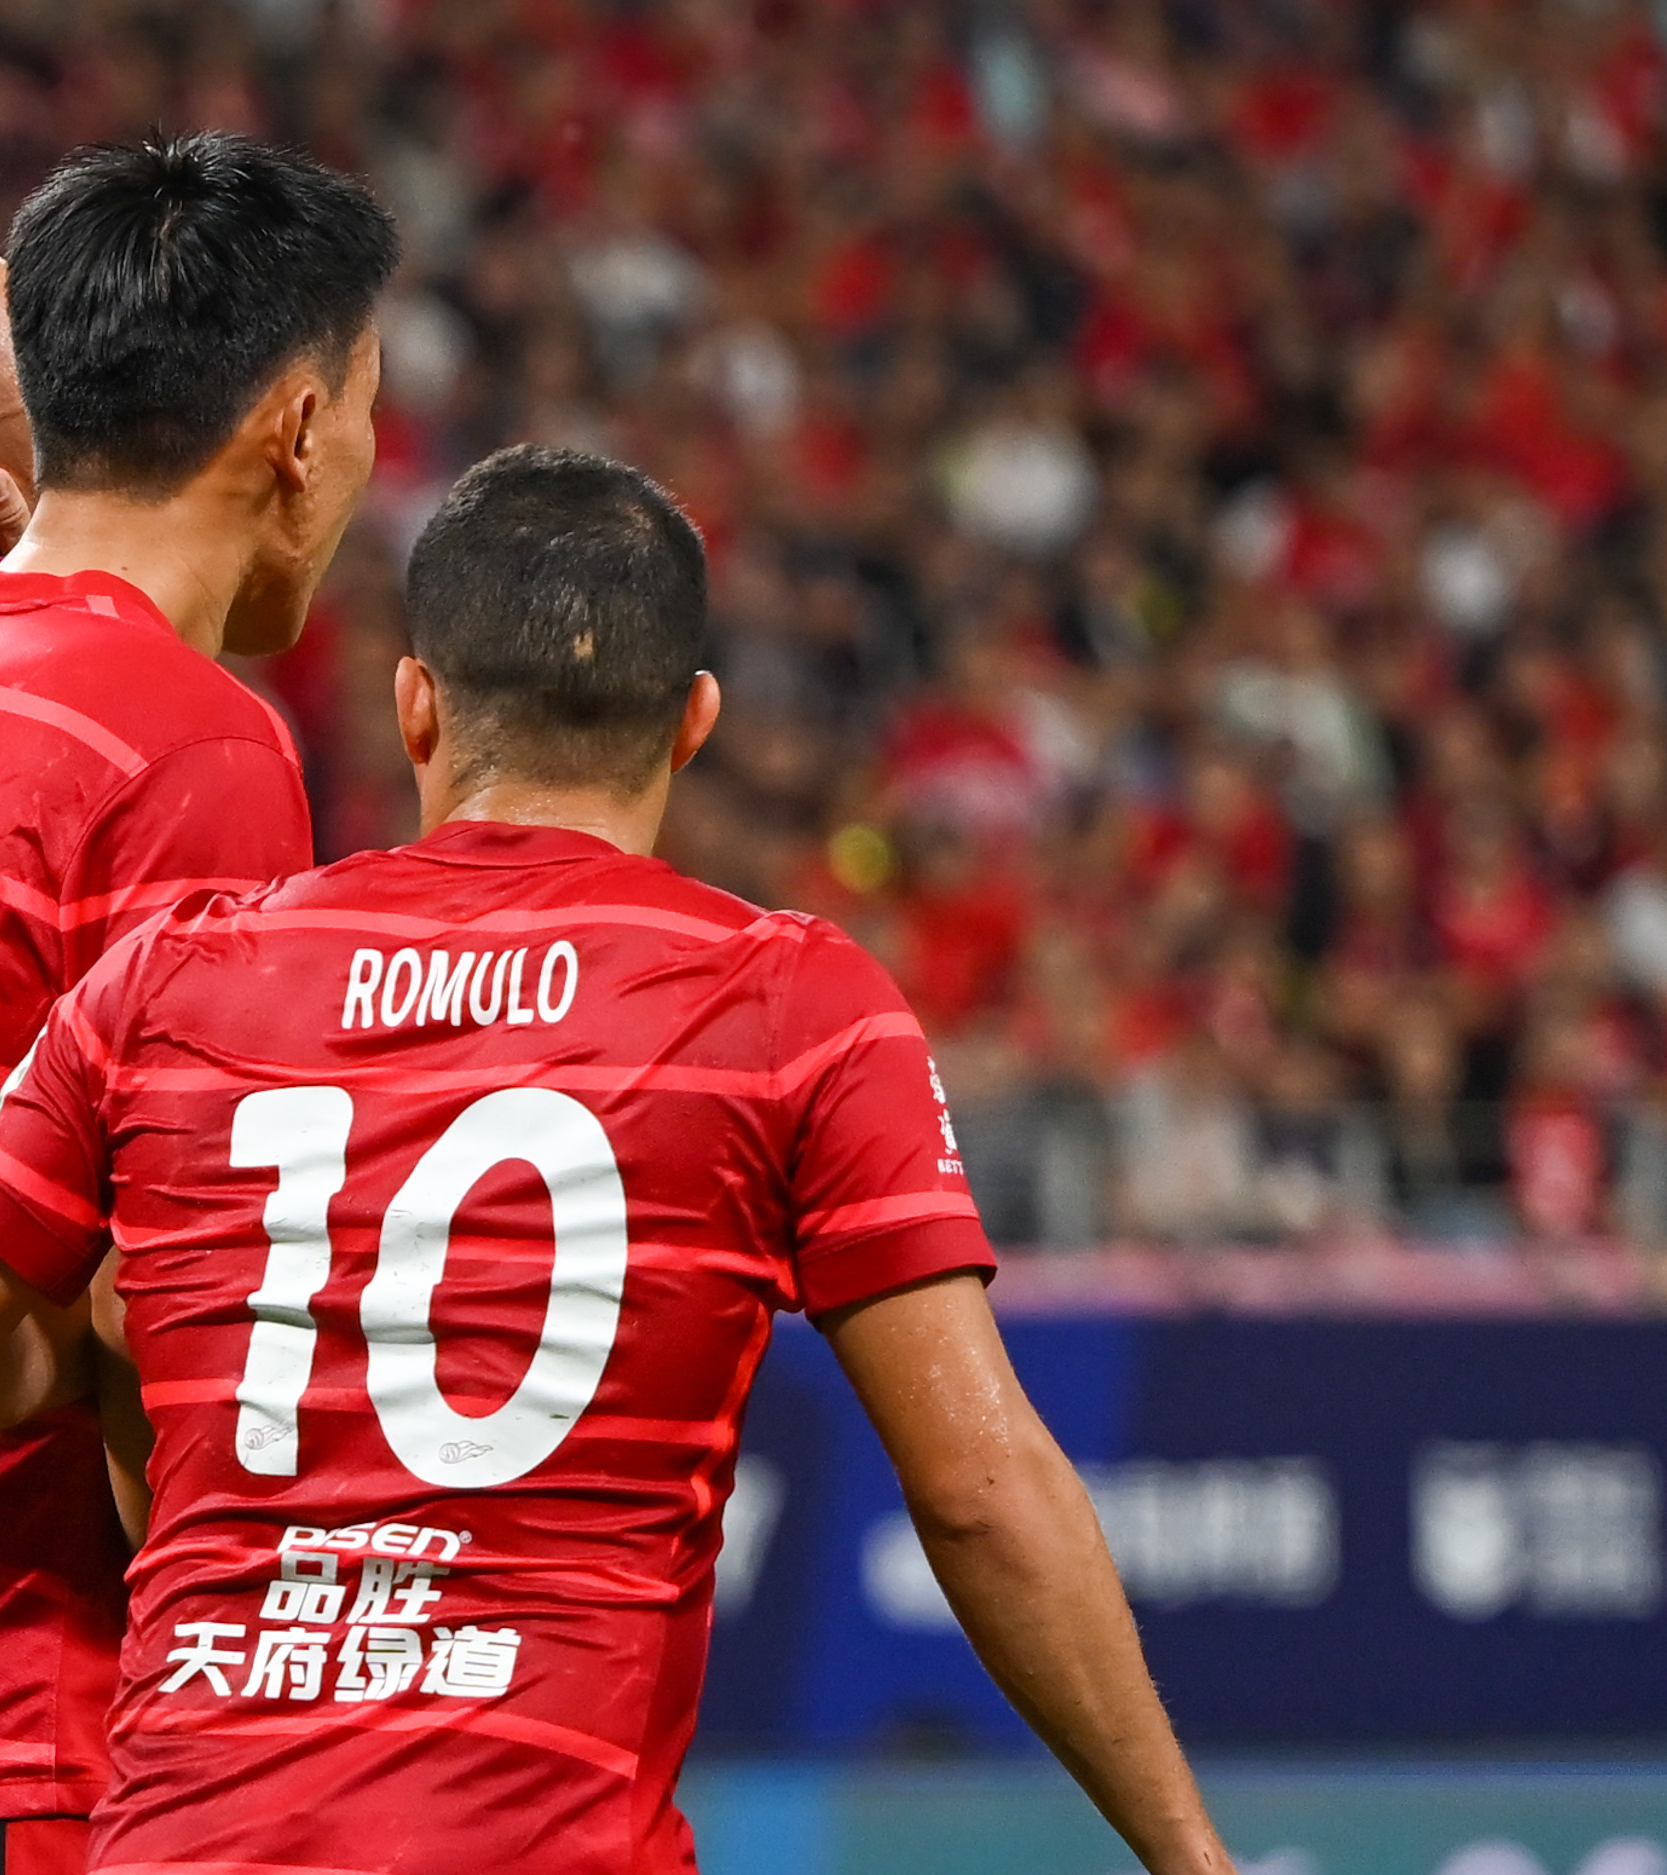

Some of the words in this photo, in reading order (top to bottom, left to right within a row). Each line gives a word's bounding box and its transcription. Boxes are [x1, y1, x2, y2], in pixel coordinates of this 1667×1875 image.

[341, 940, 579, 1030] ROMULO
[229, 1085, 628, 1489] 10
[277, 1521, 463, 1562] PISEN
[258, 1549, 452, 1625] 品胜
[157, 1620, 523, 1703] 天府绿道
